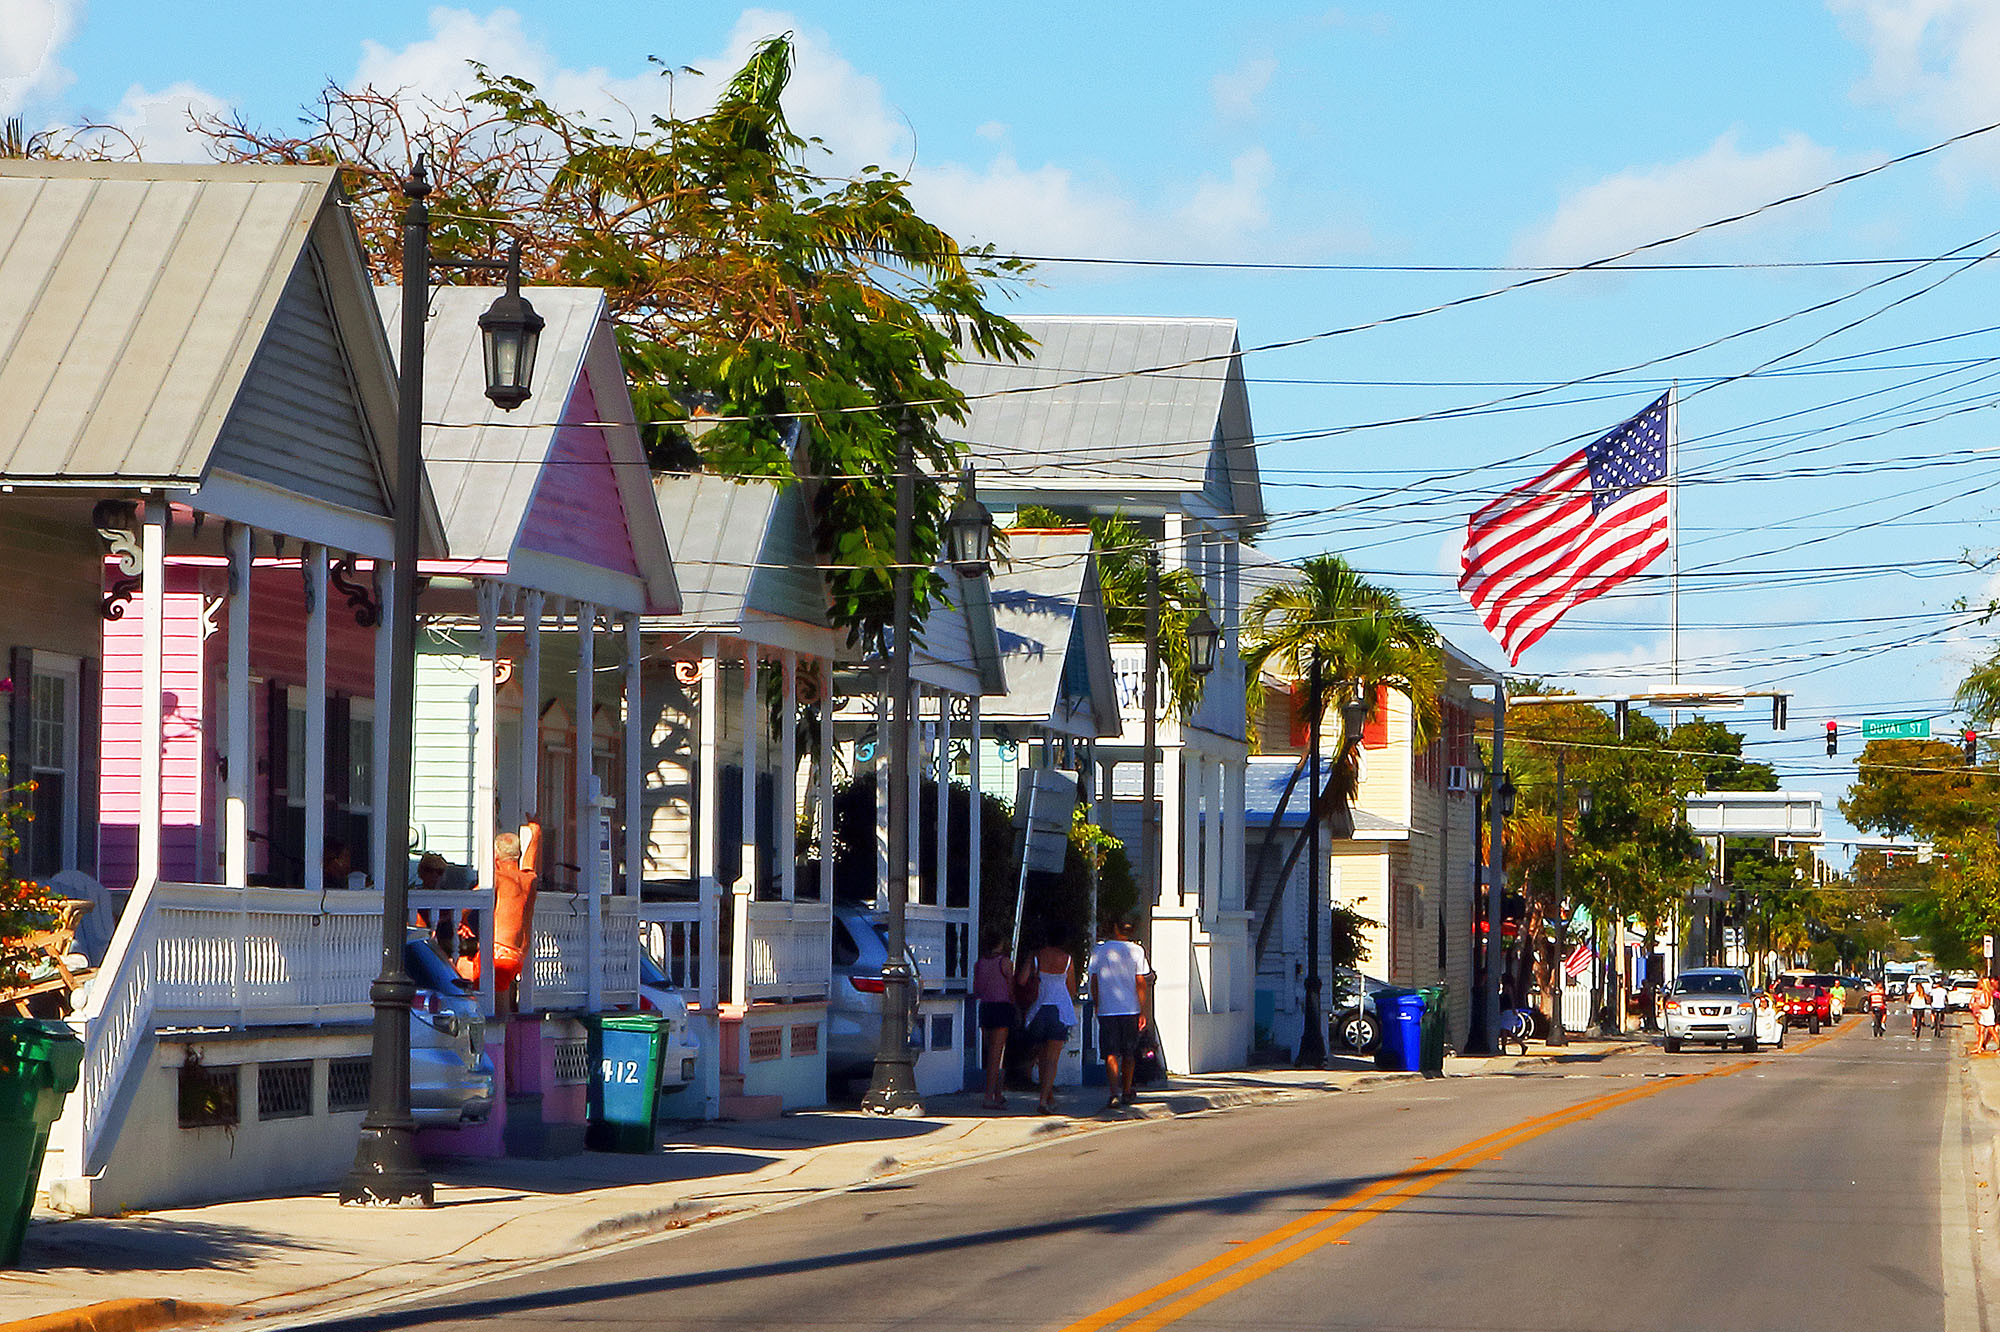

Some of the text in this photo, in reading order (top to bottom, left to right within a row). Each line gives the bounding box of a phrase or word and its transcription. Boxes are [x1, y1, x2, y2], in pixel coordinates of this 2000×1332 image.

[1870, 723, 1922, 734] DUVAL ST
[601, 1059, 639, 1084] 412
